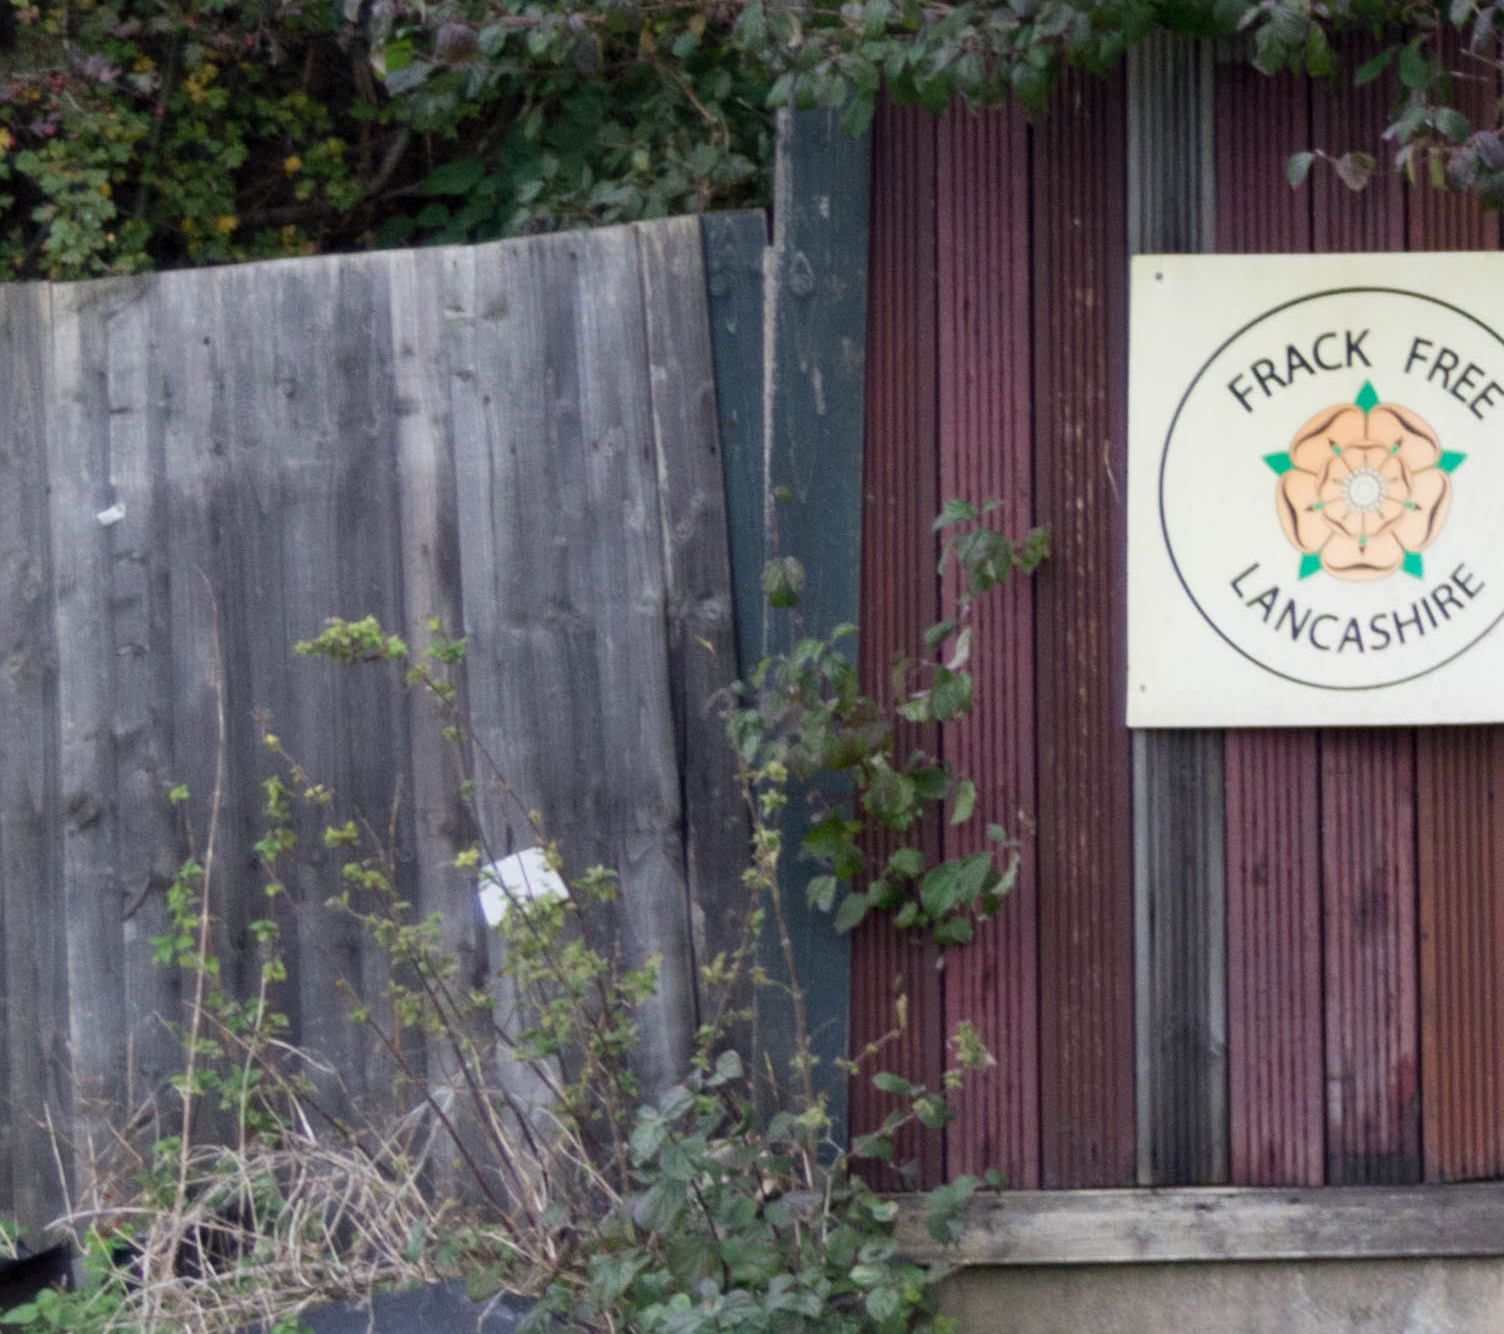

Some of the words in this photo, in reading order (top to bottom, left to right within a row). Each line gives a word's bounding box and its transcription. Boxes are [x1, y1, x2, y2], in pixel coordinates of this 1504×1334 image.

[1227, 329, 1372, 412] FRACK
[1404, 336, 1504, 420] FREE
[1230, 563, 1485, 653] LANCASHIRE
